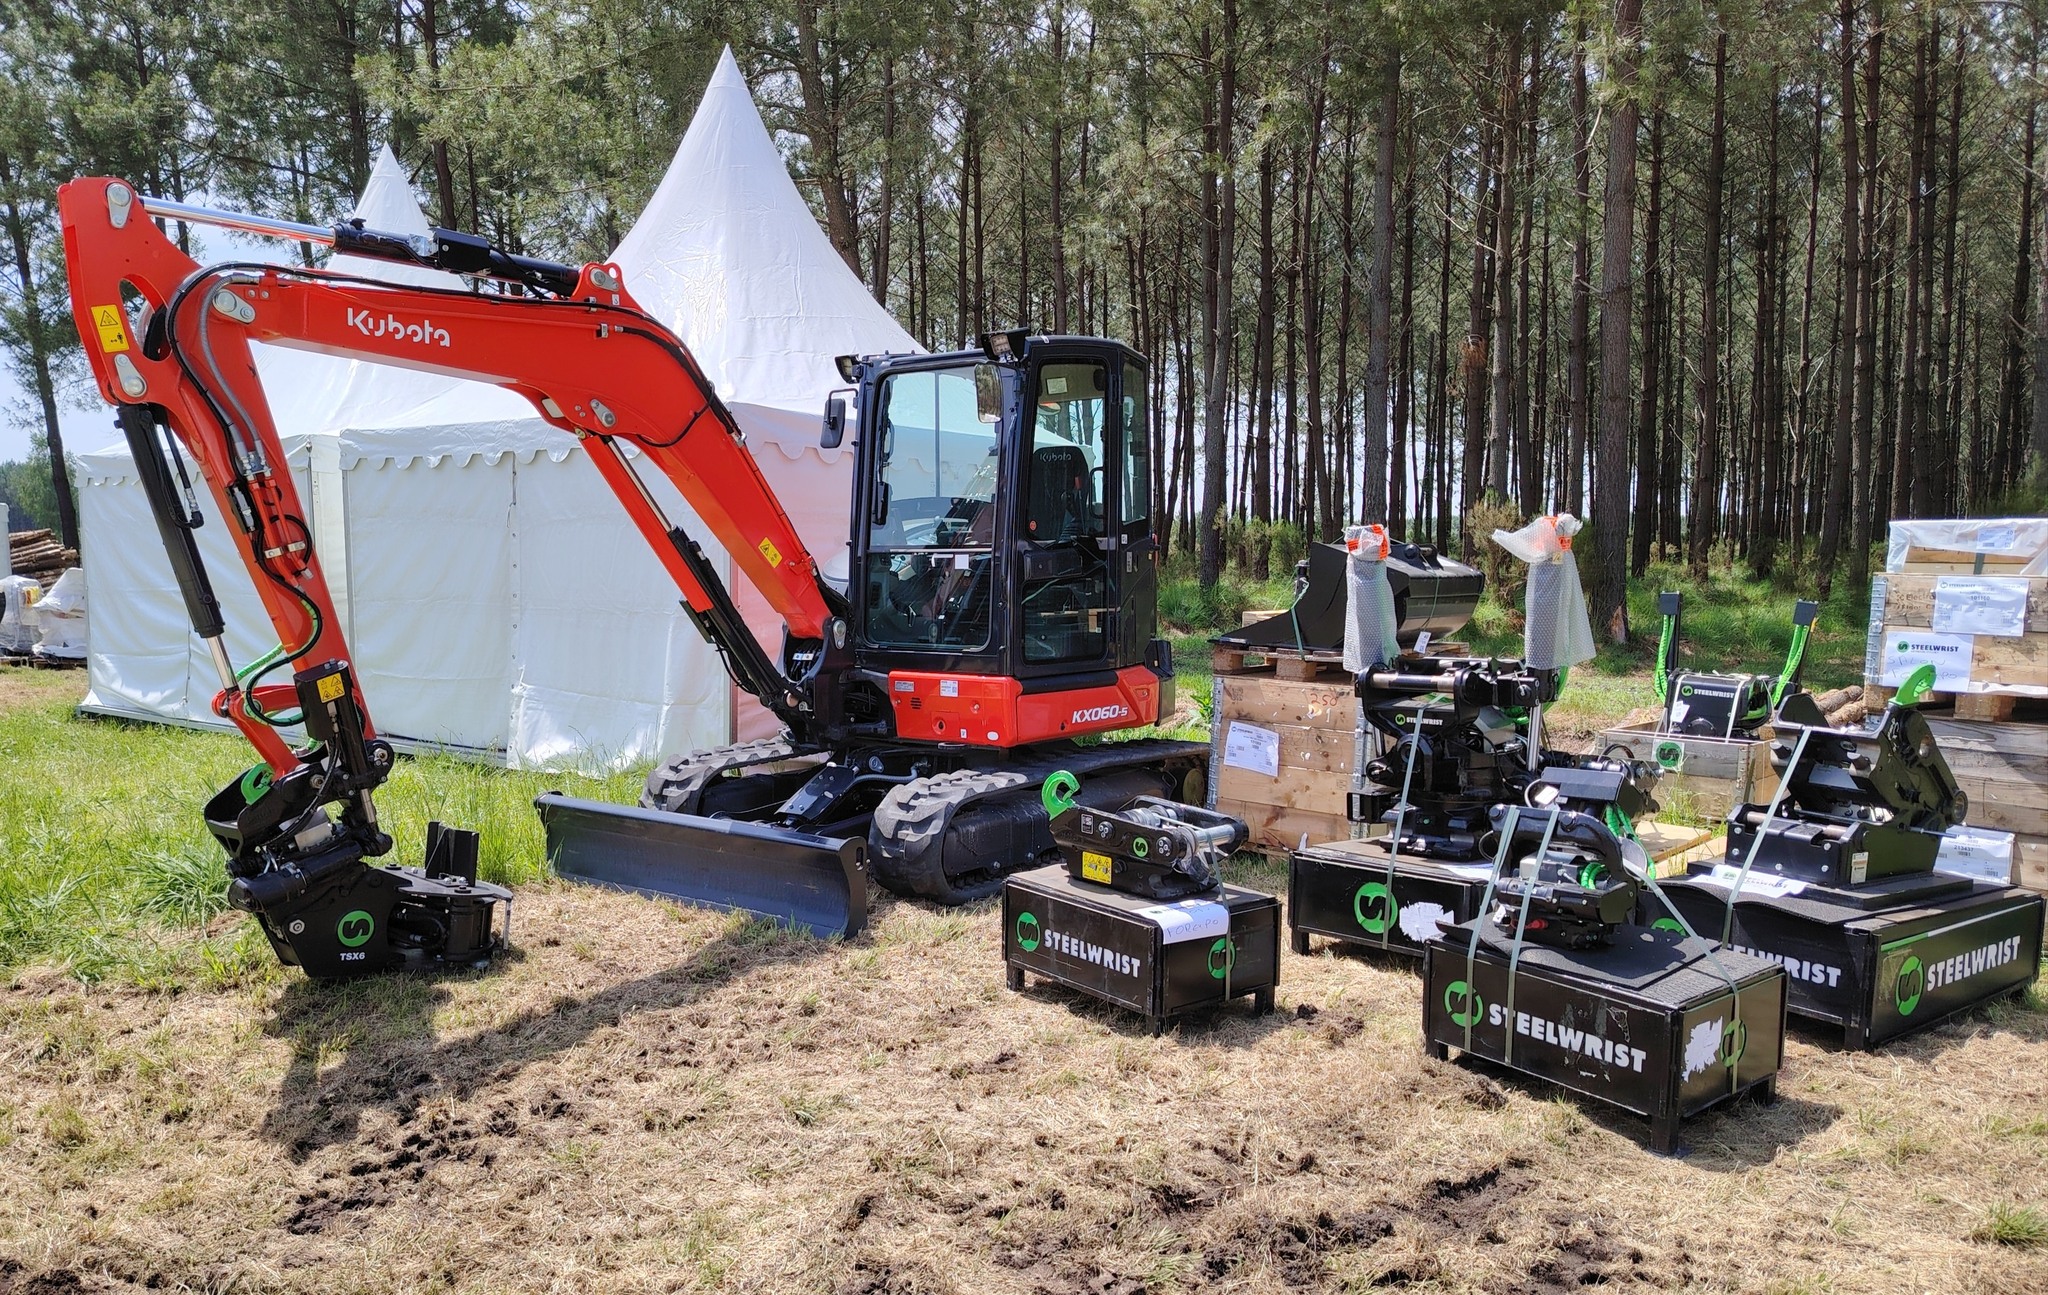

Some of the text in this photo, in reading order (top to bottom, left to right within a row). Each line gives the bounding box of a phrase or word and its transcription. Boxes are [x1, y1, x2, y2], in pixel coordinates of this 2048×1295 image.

[347, 307, 451, 348] Kubota
[1040, 452, 1072, 462] Kubota
[1911, 643, 1959, 653] STEELWRIST
[1694, 688, 1735, 699] STEELWRIST
[1071, 704, 1129, 724] KX060-5
[340, 952, 366, 961] TSX6
[1044, 928, 1141, 978] STEELWRIST
[1927, 935, 2021, 992] STEELWRIST
